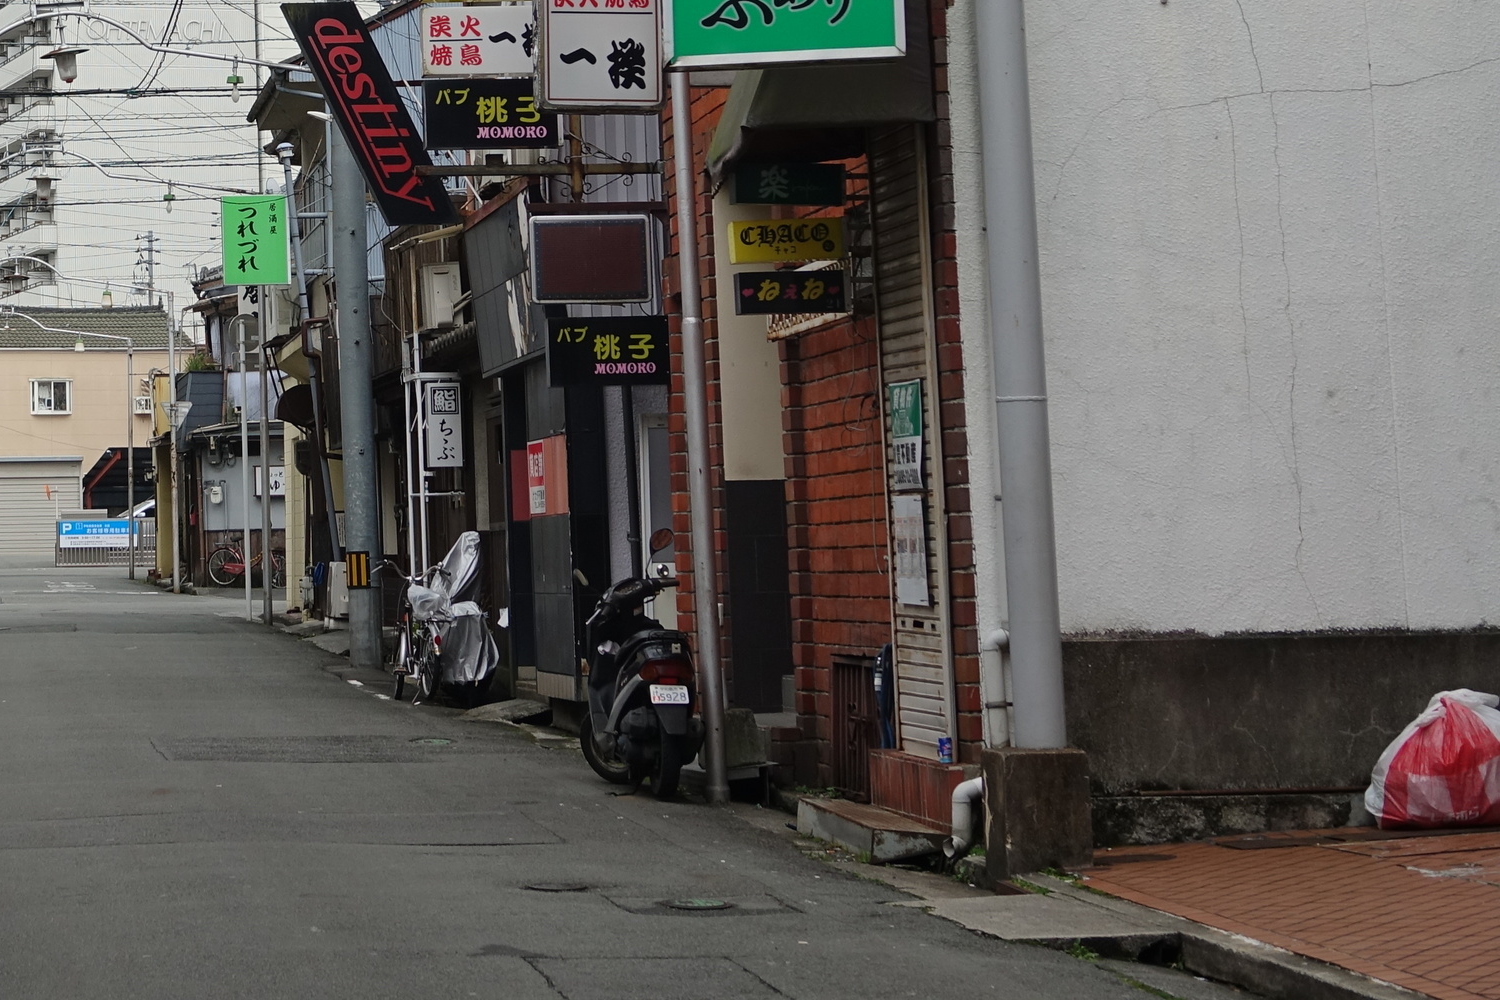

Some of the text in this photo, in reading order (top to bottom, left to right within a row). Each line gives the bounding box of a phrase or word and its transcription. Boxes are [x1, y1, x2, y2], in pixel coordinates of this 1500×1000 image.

[429, 14, 482, 38] 炭火
[430, 43, 483, 66] 焼鳥
[313, 17, 436, 213] destiny
[435, 88, 542, 124] パブ 桃子
[476, 126, 548, 139] MOMOKO
[758, 165, 790, 200] 楽
[236, 207, 260, 273] つれづれ
[740, 222, 830, 248] CHACO
[557, 326, 655, 360] パブ 桃子
[594, 361, 657, 375] MOMOKO
[434, 389, 456, 412] 鮨
